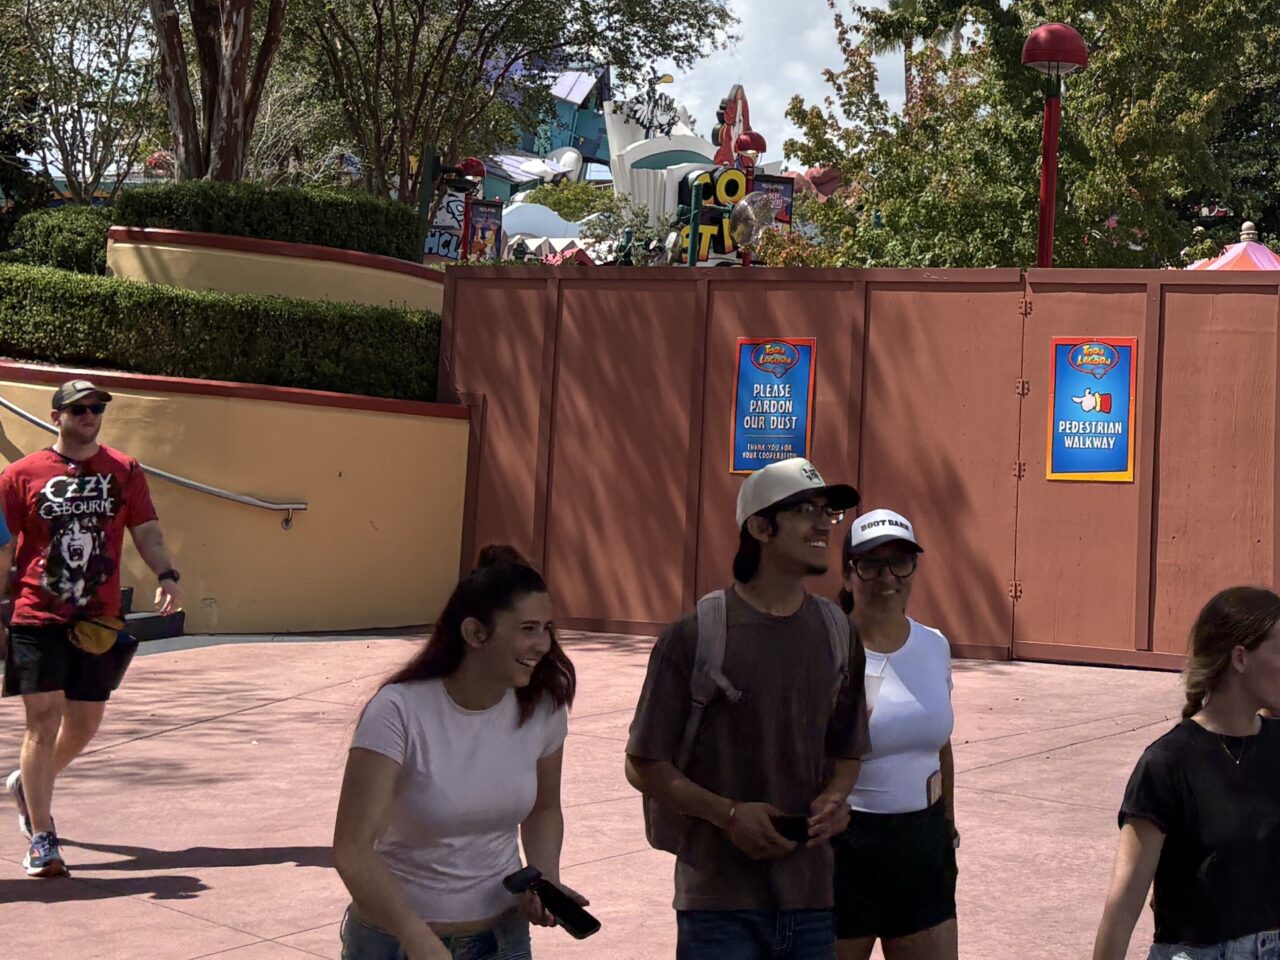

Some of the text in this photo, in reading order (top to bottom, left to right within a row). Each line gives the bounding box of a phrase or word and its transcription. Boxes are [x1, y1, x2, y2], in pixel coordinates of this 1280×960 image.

[753, 384, 791, 398] PLEASE
[749, 399, 793, 414] PARDON
[744, 415, 797, 429] OUR DUST
[1058, 420, 1122, 434] PEDESTRIAN
[1064, 435, 1116, 449] WALKWAY
[40, 473, 112, 502] OZZY
[39, 497, 115, 519] OSBOURNE
